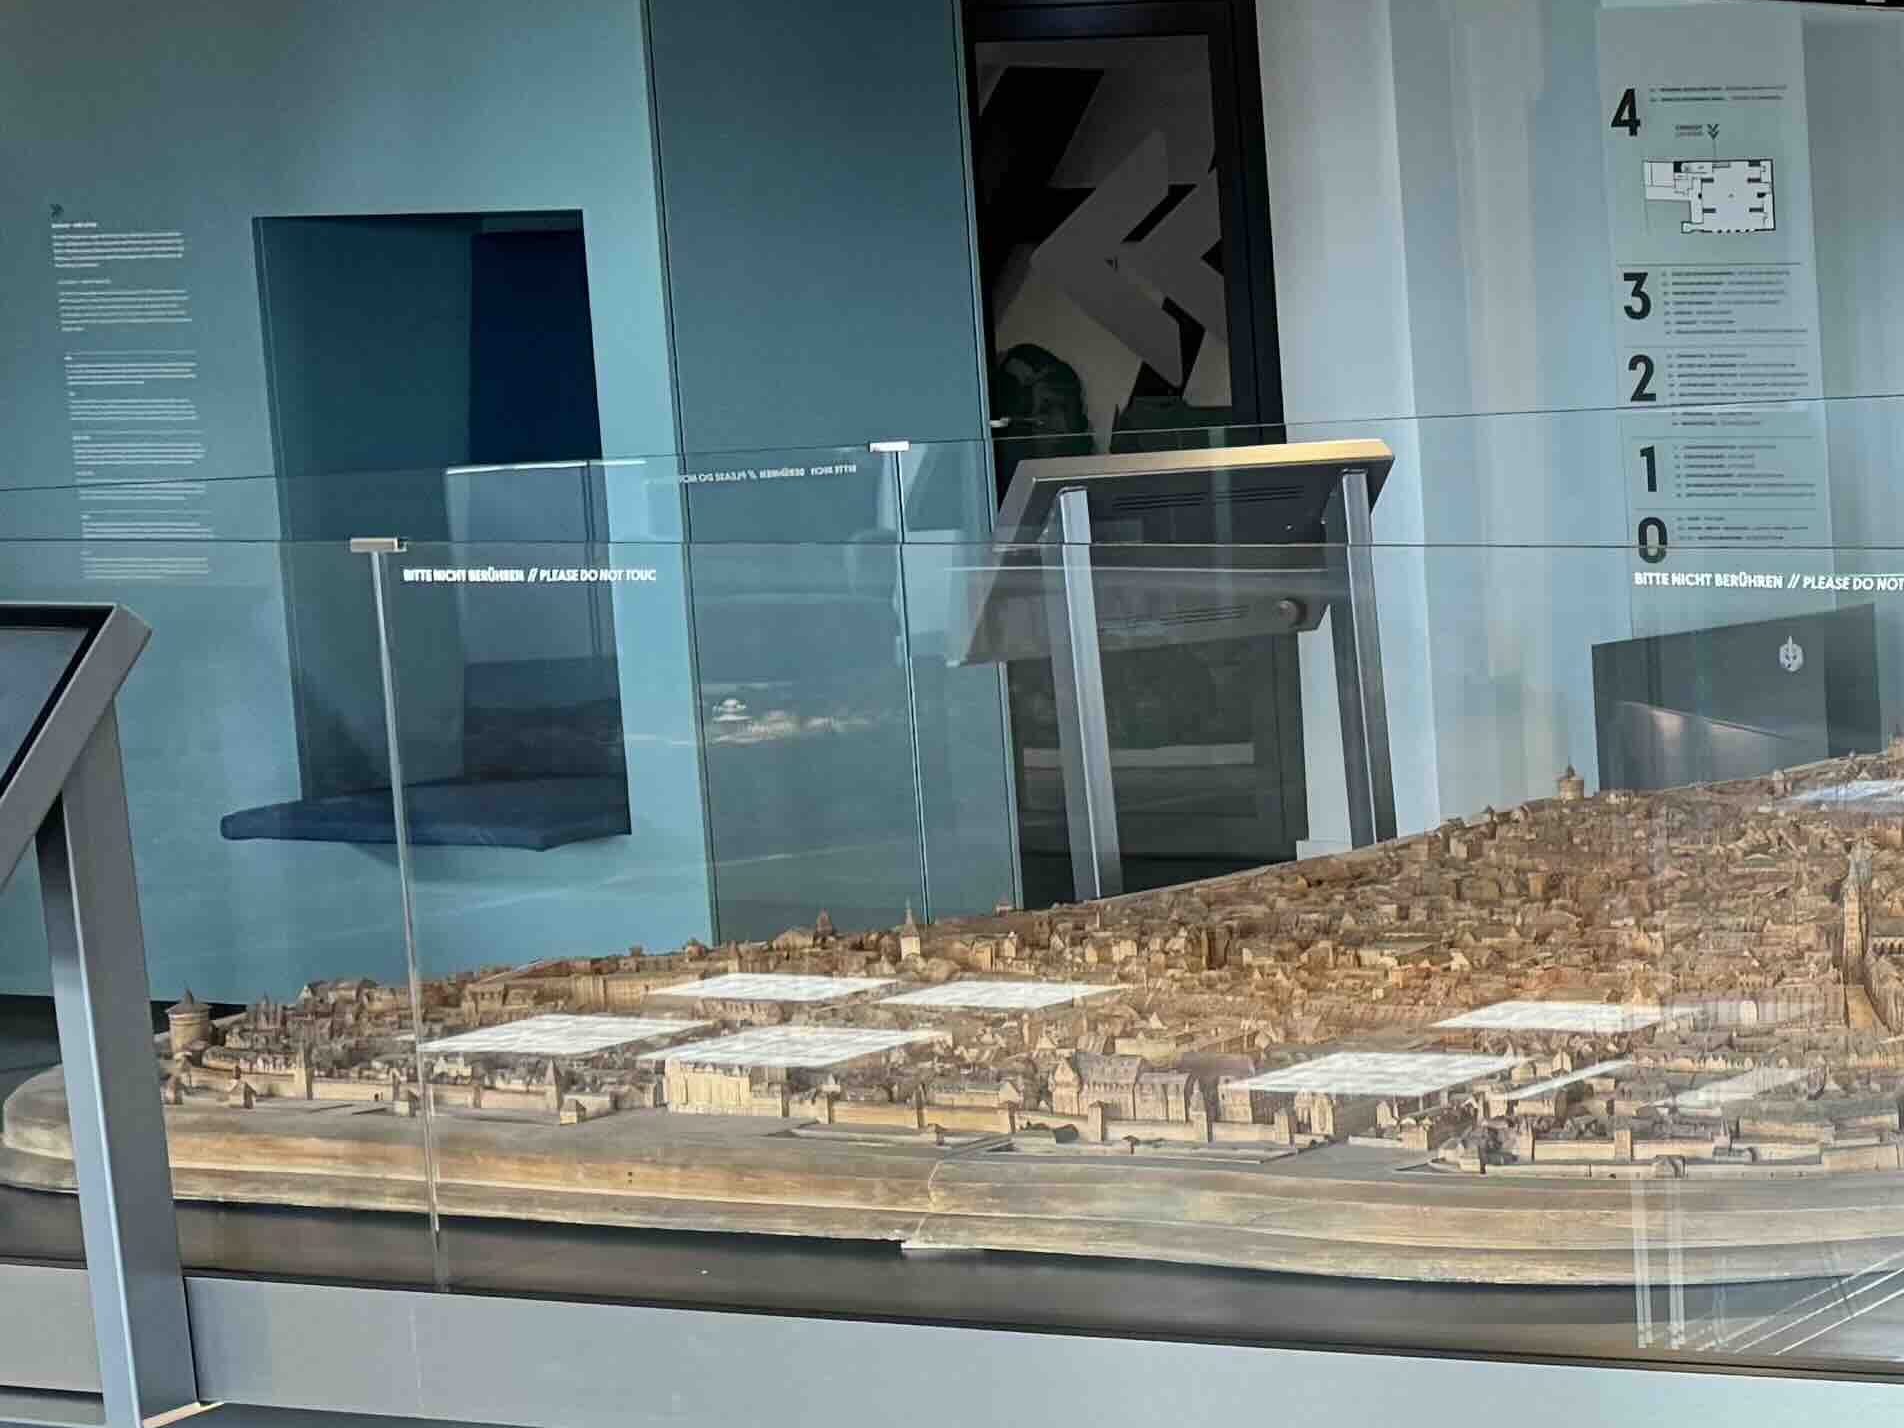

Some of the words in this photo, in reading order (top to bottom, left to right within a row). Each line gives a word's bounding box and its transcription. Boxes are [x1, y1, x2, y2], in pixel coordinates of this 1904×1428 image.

[1610, 87, 1641, 137] 4
[1623, 272, 1651, 320] 3
[1628, 354, 1657, 402] 2
[1639, 445, 1657, 493] 1
[1638, 516, 1668, 564] 0
[403, 569, 432, 582] BITTE
[432, 569, 467, 582] NICHT
[467, 566, 525, 582] BERÜHREN
[539, 569, 579, 582] PLEASE
[580, 569, 599, 582] DO
[599, 569, 624, 581] NOT
[1634, 572, 1669, 586] BITTE
[1671, 572, 1713, 587] NICHT
[1714, 571, 1784, 589] BERÜHREN
[1802, 575, 1851, 590] PLEASE
[1852, 577, 1875, 590] DO
